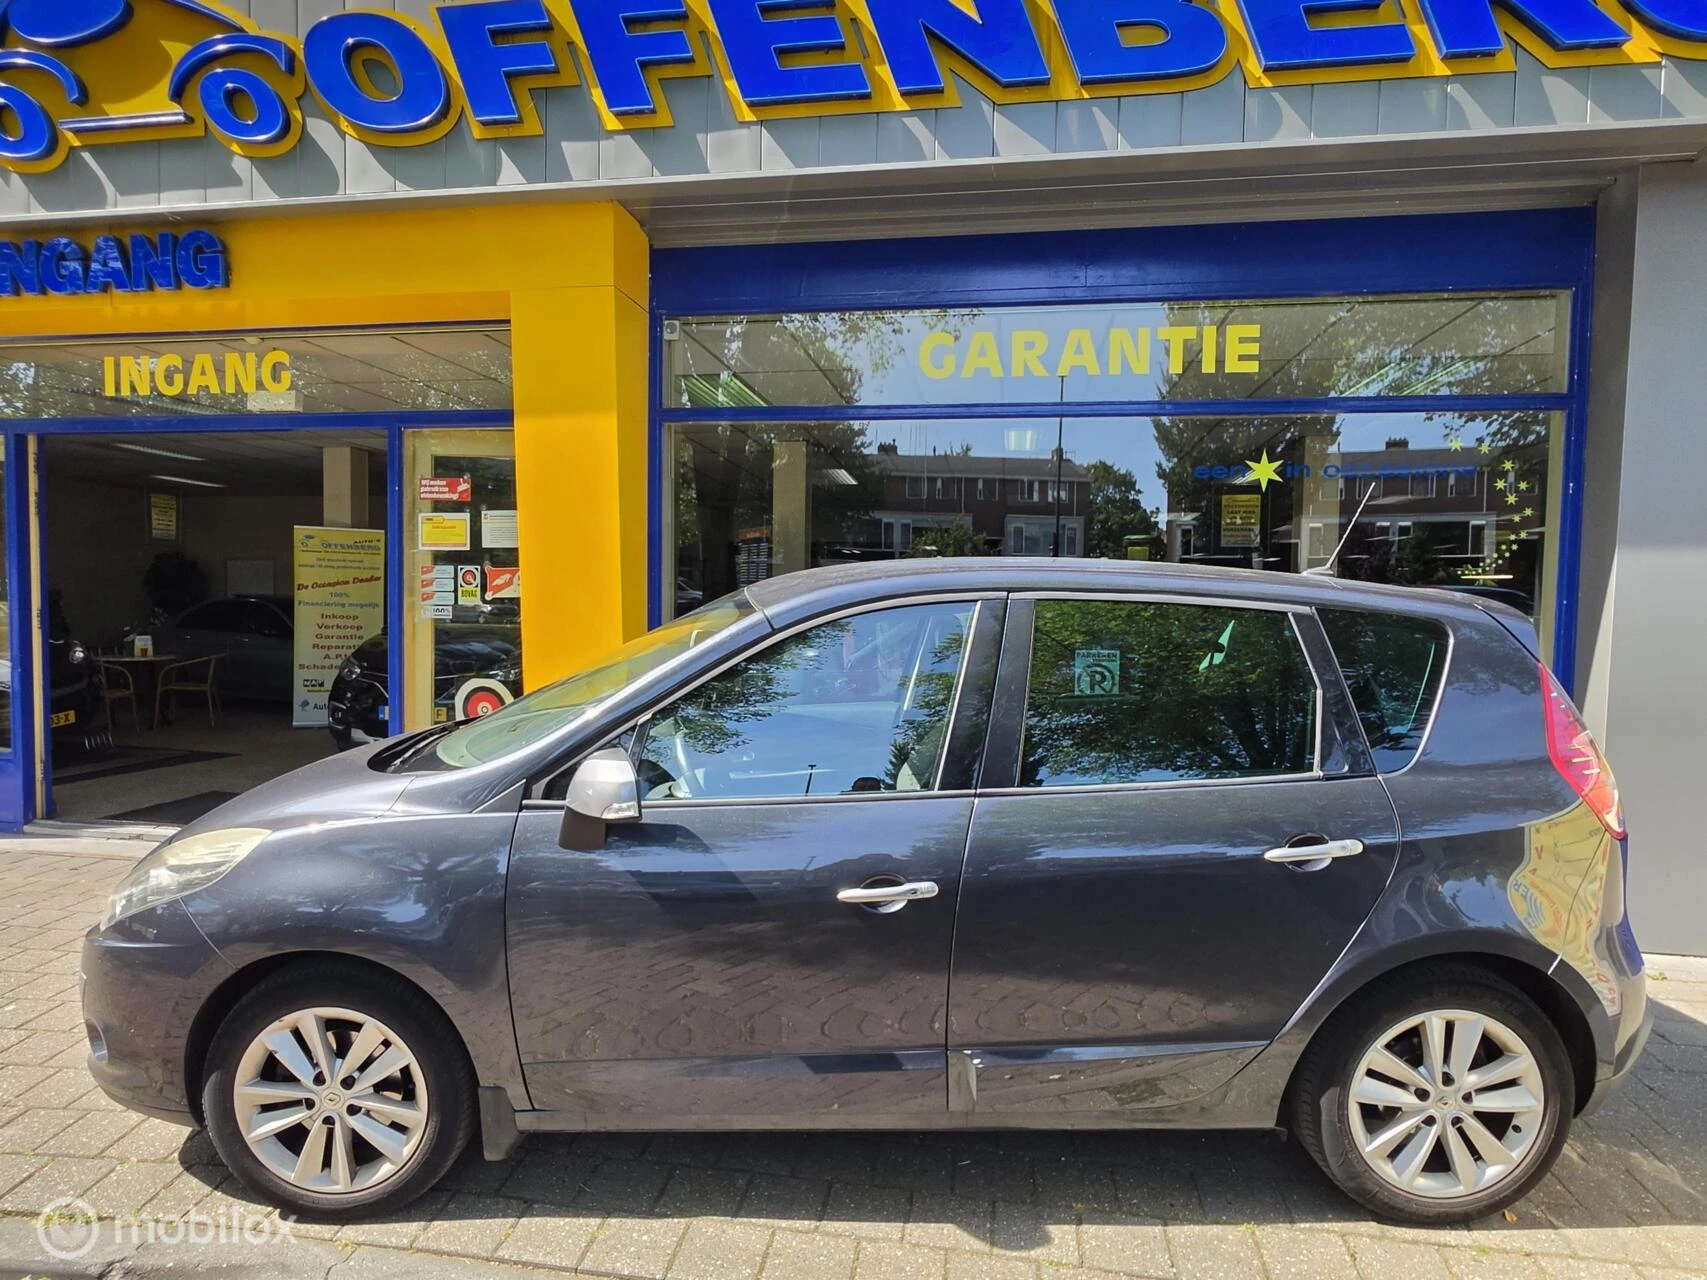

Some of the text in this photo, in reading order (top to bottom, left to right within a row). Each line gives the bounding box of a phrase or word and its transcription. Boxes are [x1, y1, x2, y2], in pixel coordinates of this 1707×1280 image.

[918, 324, 1261, 379] GARANTIE
[104, 350, 292, 397] INGANG
[1194, 464, 1247, 480] een
[1286, 461, 1311, 480] in
[321, 613, 359, 621] Inkoop
[317, 623, 363, 631] Verkoop
[312, 643, 360, 651] Reparat
